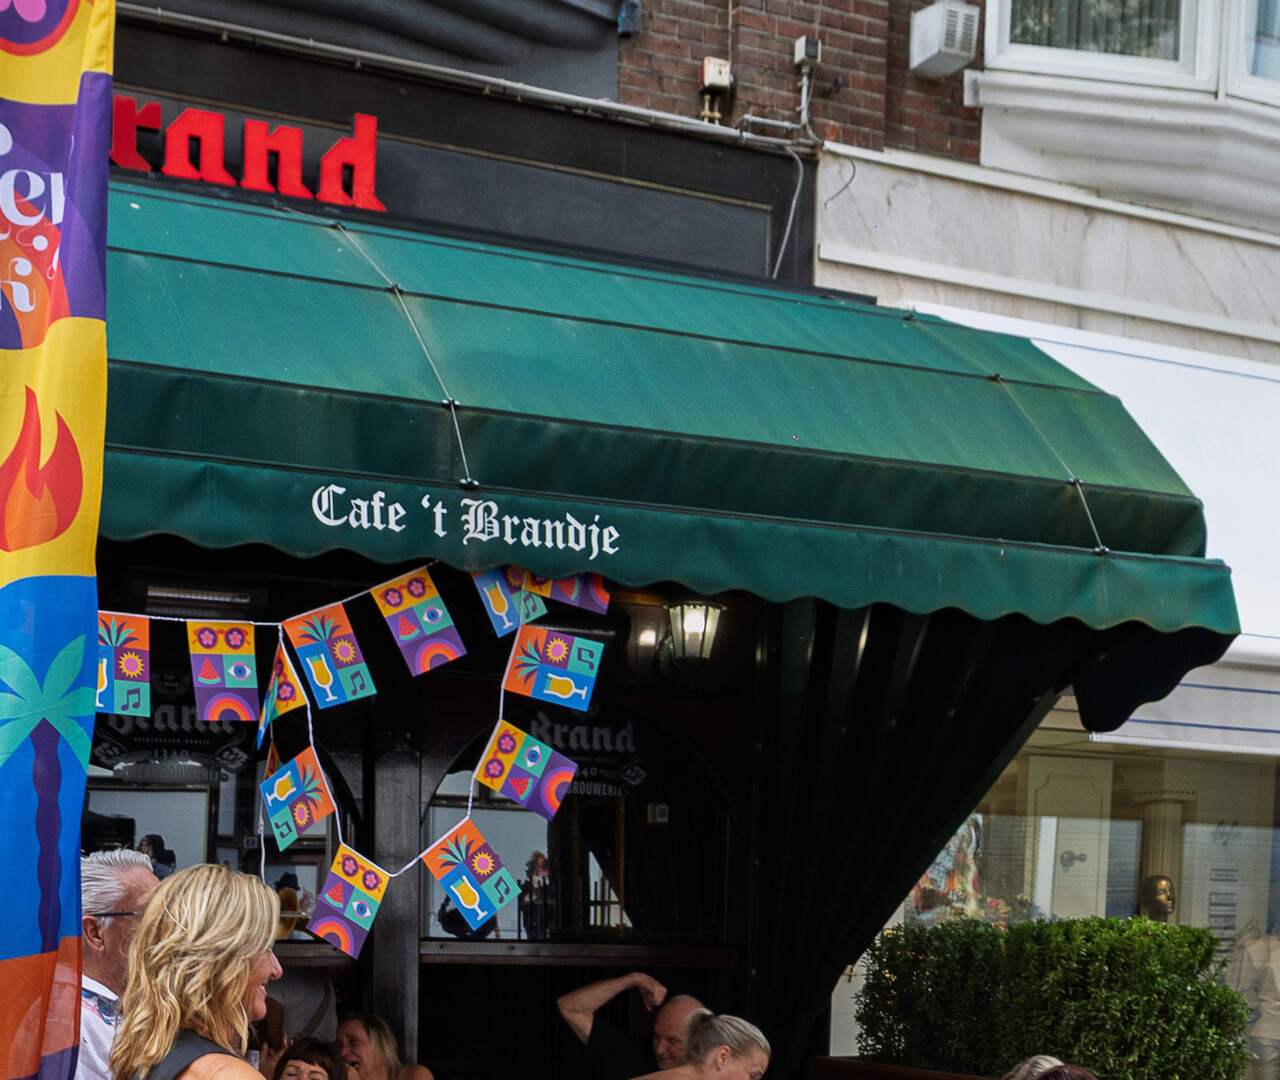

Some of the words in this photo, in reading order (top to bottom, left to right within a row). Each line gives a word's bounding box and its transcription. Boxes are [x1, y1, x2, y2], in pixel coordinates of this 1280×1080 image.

[311, 483, 407, 534] Cafe
[460, 498, 621, 560] Brandje
[530, 711, 636, 753] Brand
